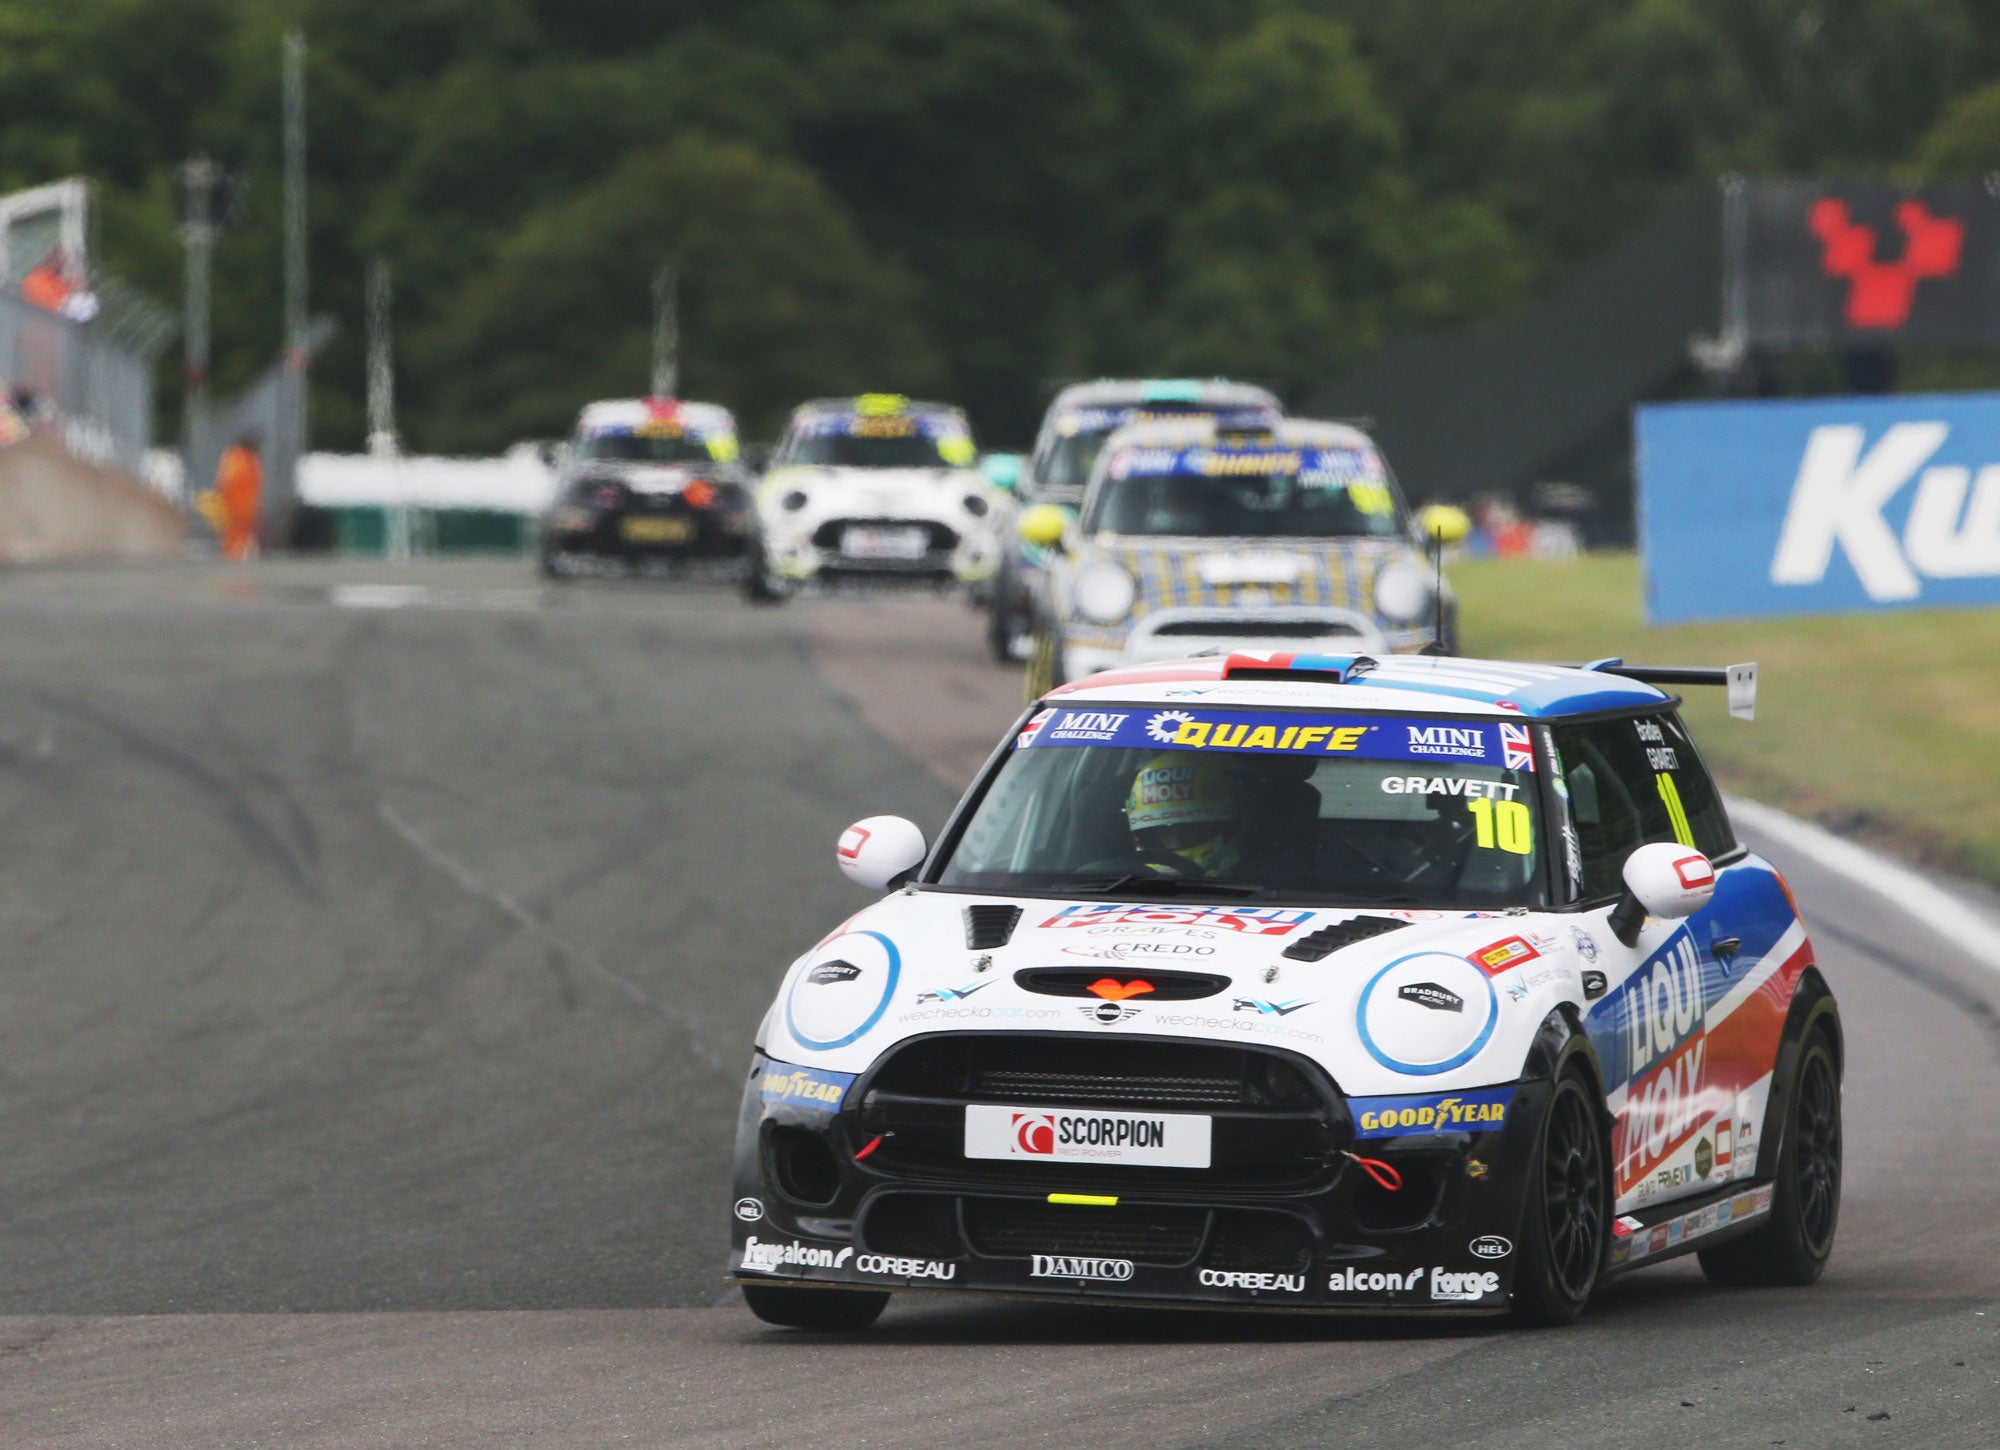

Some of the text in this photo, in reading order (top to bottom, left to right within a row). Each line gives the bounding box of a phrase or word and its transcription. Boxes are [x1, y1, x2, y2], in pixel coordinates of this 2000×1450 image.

[1055, 712, 1130, 732] MINI
[1050, 729, 1115, 741] CHALLENGE
[1171, 721, 1368, 751] QUAIFE
[1407, 726, 1485, 749] MINI
[1409, 744, 1485, 758] CHALLENGE
[1380, 776, 1520, 801] GRAVETT
[1468, 797, 1533, 855] 10
[1048, 911, 1297, 935] MOLY
[1087, 925, 1218, 940] GRAVES
[1111, 942, 1217, 956] CREDO
[1403, 987, 1461, 1005] BRADBURY
[1628, 935, 1703, 1075] LIQUI
[898, 1006, 1061, 1023] wecheckacar.com
[1154, 1013, 1326, 1044] wecheckacar.com
[1360, 1100, 1505, 1131] GOODYEAR
[1621, 1038, 1705, 1182] MOLY
[1058, 1116, 1164, 1148] SCORPION
[784, 1239, 834, 1268] alcon
[1477, 1244, 1506, 1255] HEL
[856, 1253, 956, 1280] CORBEAU
[1030, 1254, 1130, 1279] DAMICO
[1328, 1266, 1403, 1292] alcon
[1199, 1268, 1306, 1293] CORBEAU
[1430, 1266, 1500, 1300] forge
